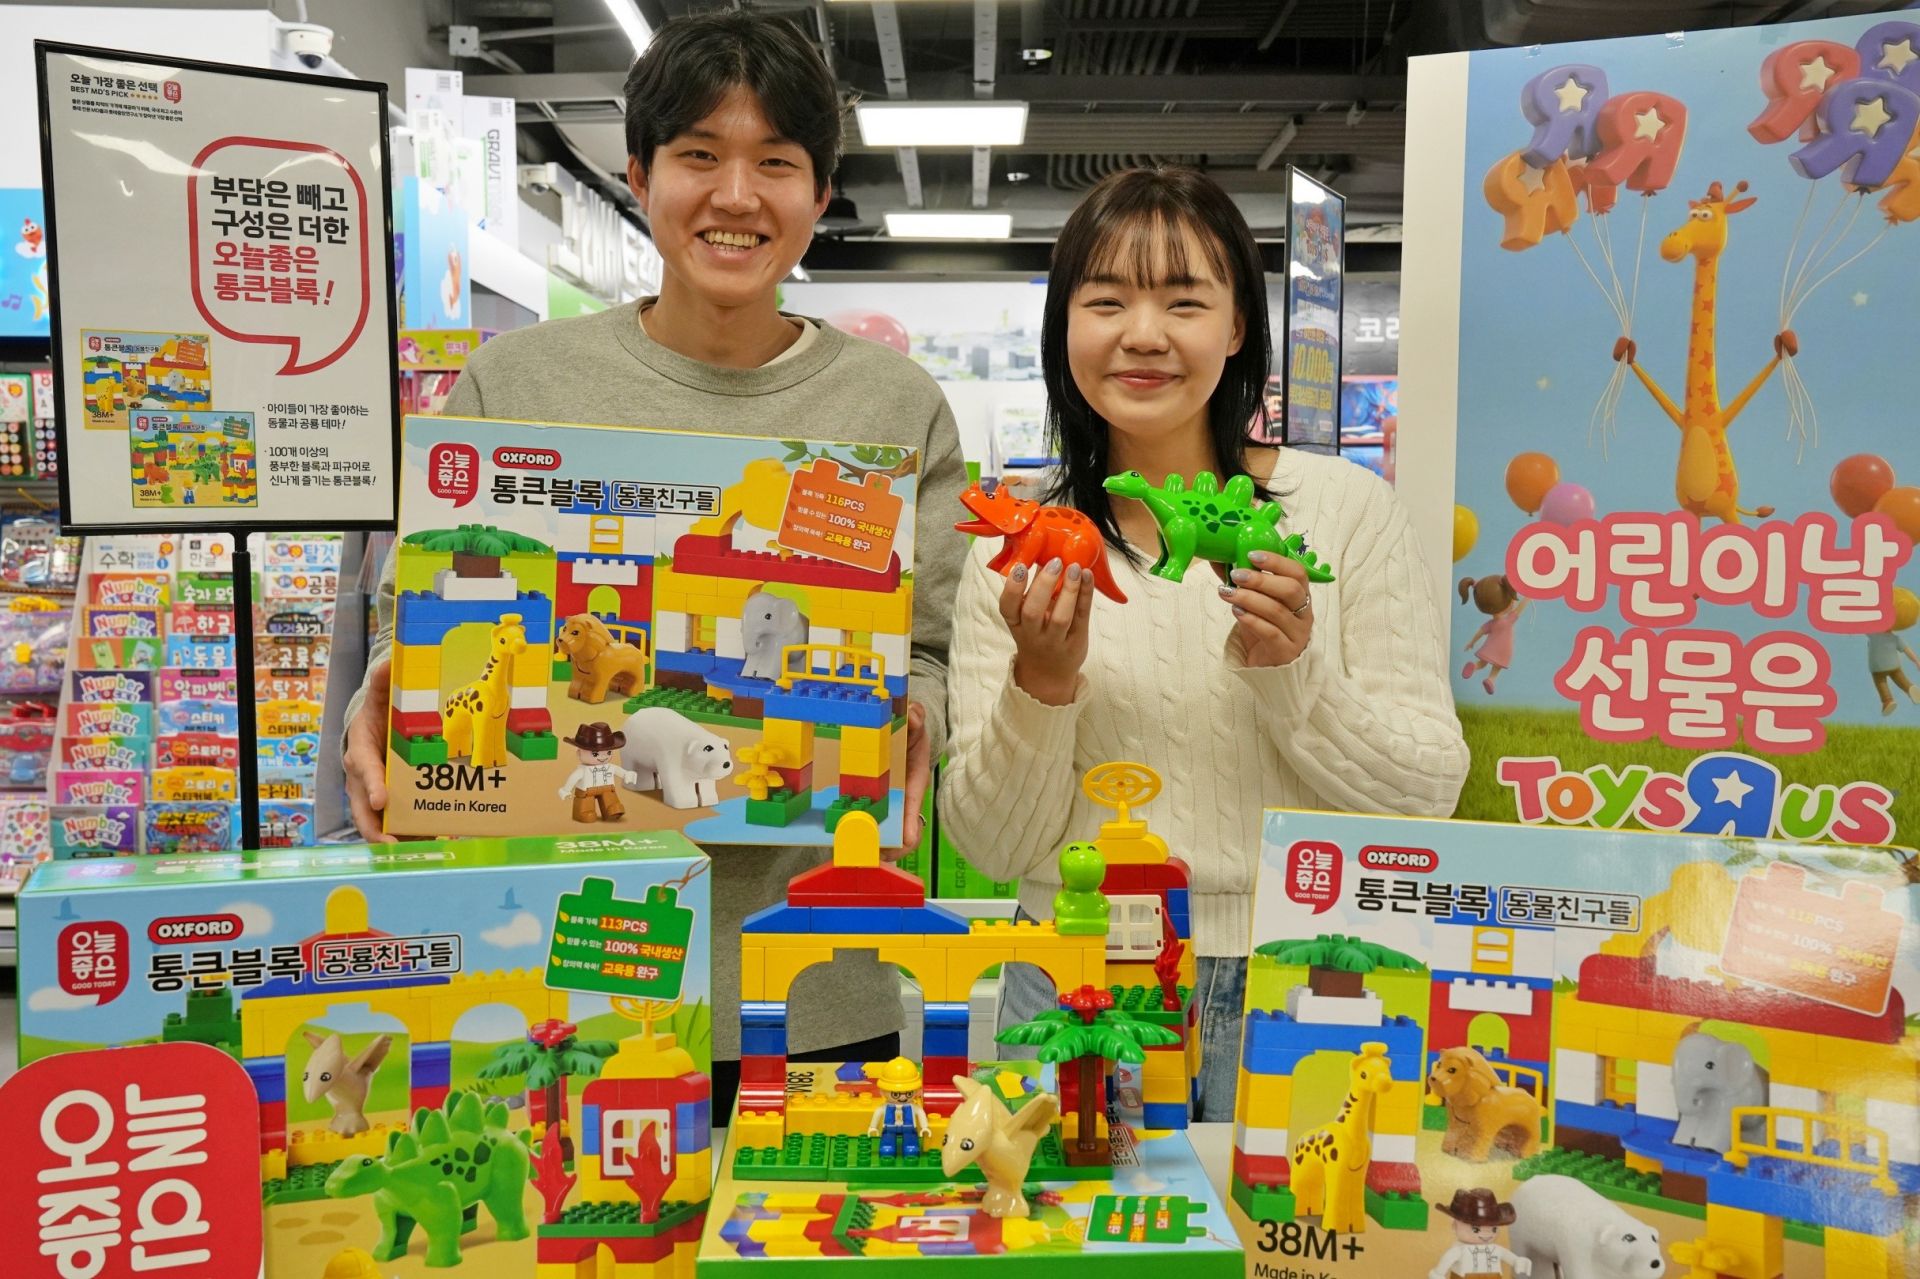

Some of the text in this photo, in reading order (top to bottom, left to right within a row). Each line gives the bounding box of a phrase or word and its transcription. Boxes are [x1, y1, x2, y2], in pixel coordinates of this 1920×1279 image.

[70, 74, 158, 94] 오늘 가장 좋은 선택
[70, 86, 129, 98] BEST MD'S PICK
[210, 176, 348, 212] 부담은 빼고
[212, 208, 350, 245] 구성은 더한
[212, 242, 320, 274] 오늘좋은
[214, 272, 335, 306] 통큰블록!
[267, 403, 369, 416] 아이들이 가장 좋아하는
[268, 418, 346, 430] 동물과 공룡 테마!
[269, 446, 329, 458] 100개 이상의
[500, 452, 554, 466] OXFORD
[270, 460, 371, 472] 풍부한 블록과 피규어로
[270, 475, 376, 486] 신나게 즐기는 통큰블록!
[490, 474, 715, 511] 통큰블록 동물친구들
[826, 494, 865, 512] 116PCS
[828, 513, 856, 529] 100%
[857, 521, 893, 539] 국내생산
[825, 532, 852, 547] 교육용
[853, 538, 871, 552] 완구
[100, 551, 135, 569] 수학
[303, 544, 334, 564] 탈것
[1516, 520, 1898, 622] 어린이날
[101, 578, 160, 596] Number
[184, 586, 211, 602] 숫자
[308, 576, 337, 595] 공룡
[94, 614, 154, 628] Number
[197, 614, 231, 634] 한글
[82, 674, 143, 692] Number
[174, 680, 226, 700] 알파벳
[272, 680, 308, 700] 탈것
[1565, 636, 1825, 744] 선물은
[79, 708, 138, 725] Number
[191, 712, 224, 724] 스티커
[72, 742, 134, 758] Number
[415, 762, 506, 791] 38M+
[70, 780, 131, 797] Number
[414, 798, 507, 813] Made in Korea
[65, 816, 125, 833] Number
[556, 838, 658, 849] 38M+
[1366, 851, 1430, 867] OXFORD
[1355, 878, 1632, 926] 통큰블록 동물친구들
[157, 920, 234, 938] OXFORD
[600, 917, 648, 933] 113PCS
[604, 940, 638, 954] 100%
[640, 944, 684, 960] 국내생산
[1791, 934, 1833, 954] 100%
[147, 942, 453, 992] 통큰블록 공룡친구들
[602, 962, 635, 977] 교육용
[636, 965, 658, 980] 완구
[72, 980, 116, 990] GOOD TODAY
[1257, 1218, 1364, 1262] 38M+
[1254, 1262, 1298, 1279] Made
